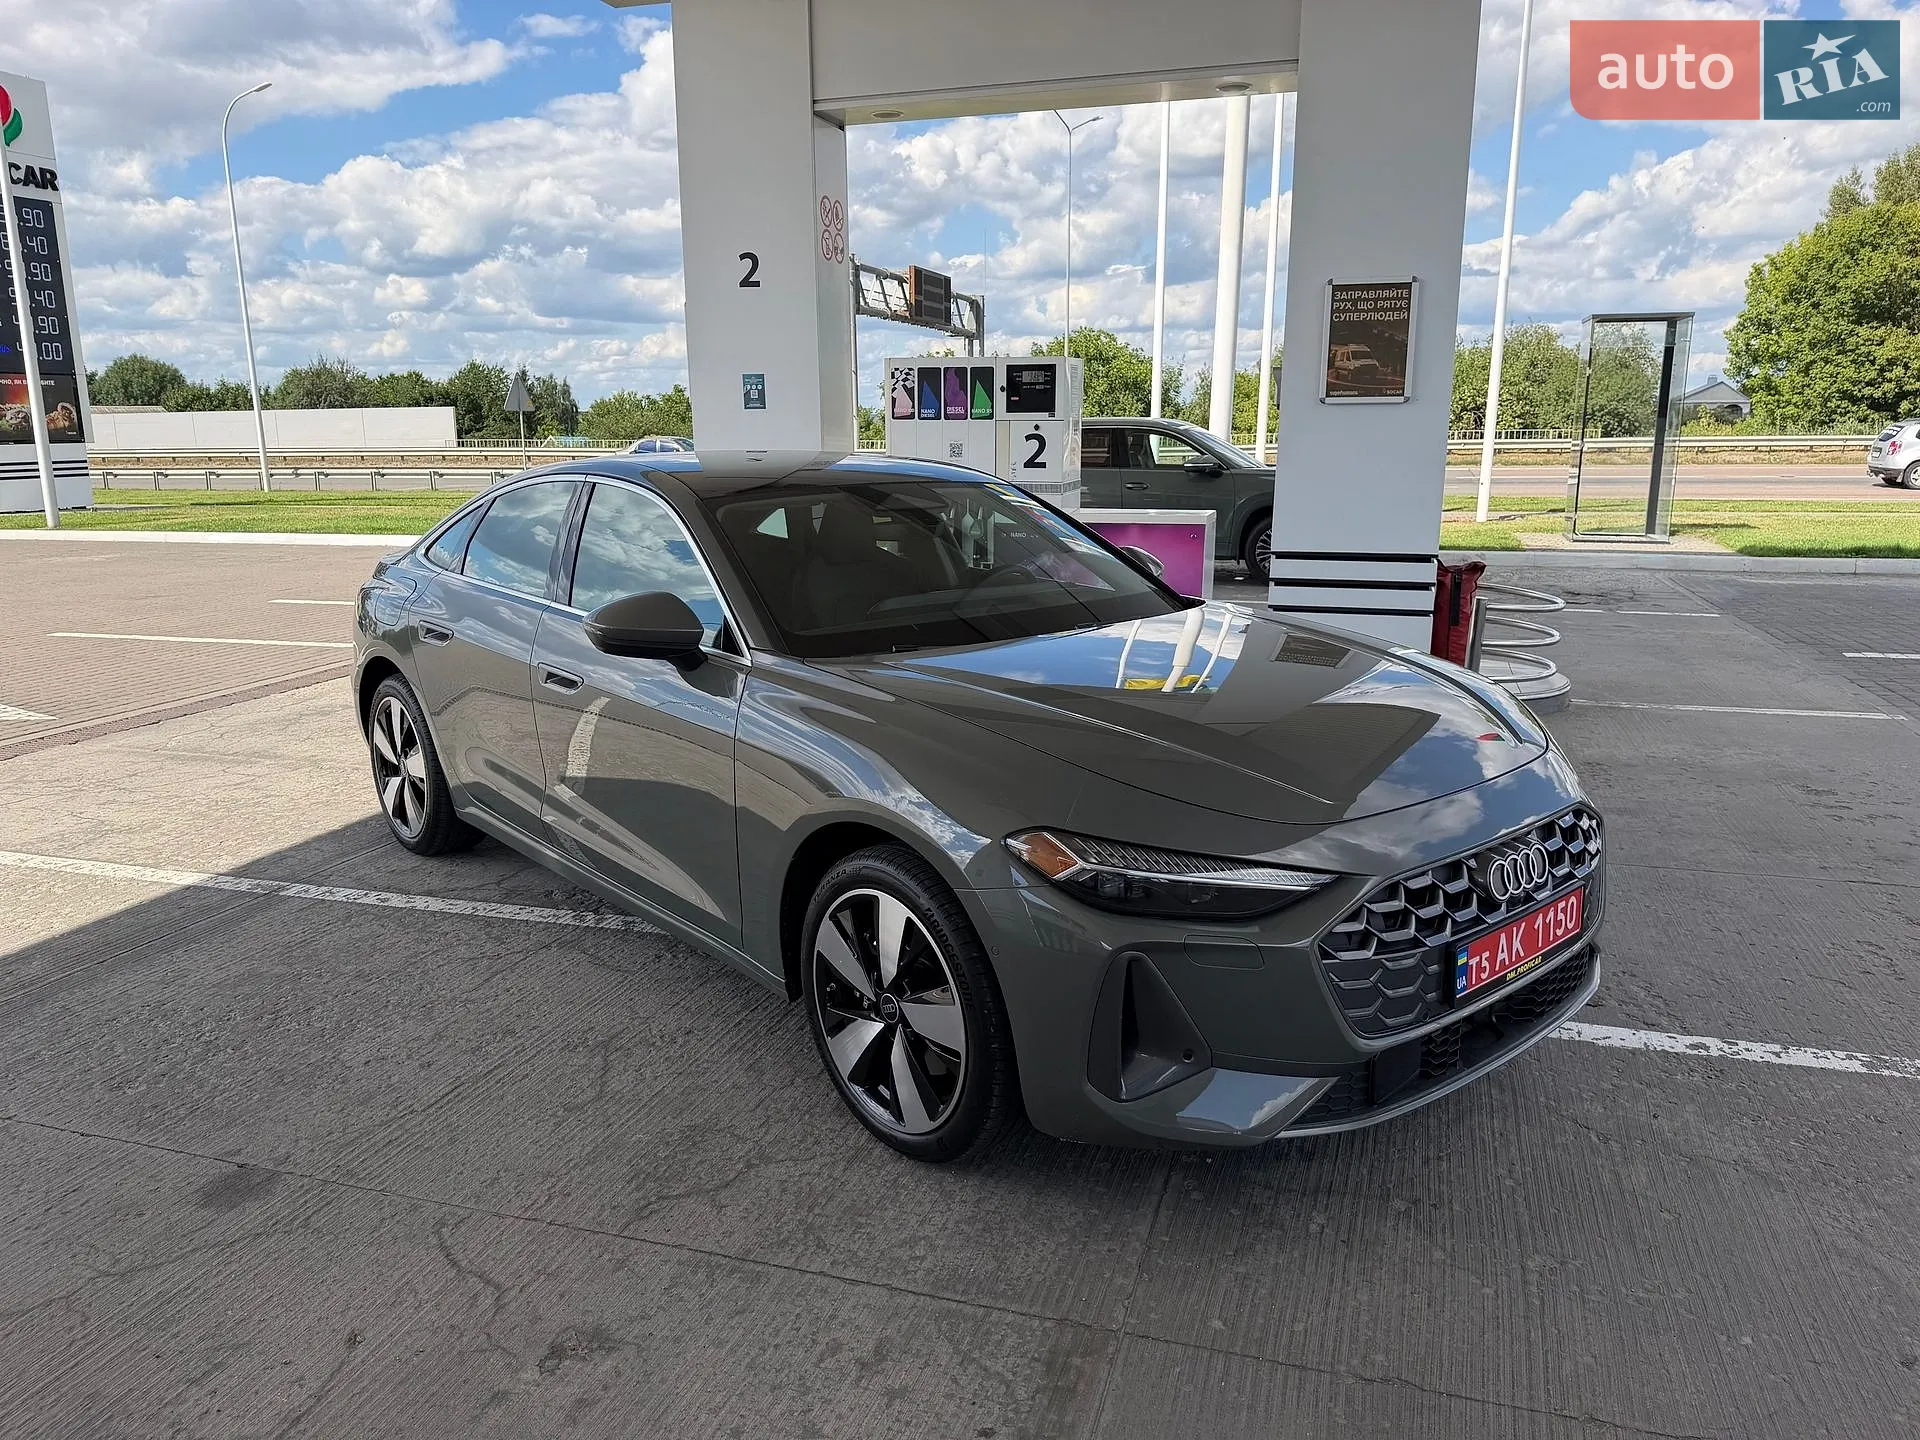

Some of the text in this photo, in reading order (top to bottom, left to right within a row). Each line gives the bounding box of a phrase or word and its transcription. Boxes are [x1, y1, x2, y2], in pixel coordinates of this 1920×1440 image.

[738, 251, 761, 288] 2
[1334, 287, 1409, 300] ЗАПРАВЛЯЙТЕ
[1332, 299, 1409, 311] РУХ, ЩО РЯТУЄ
[1332, 309, 1408, 322] СУПЕРЛЮДЕЙ
[1022, 432, 1048, 469] 2
[1468, 895, 1577, 985] T5 AK 1150
[1456, 974, 1467, 990] UA
